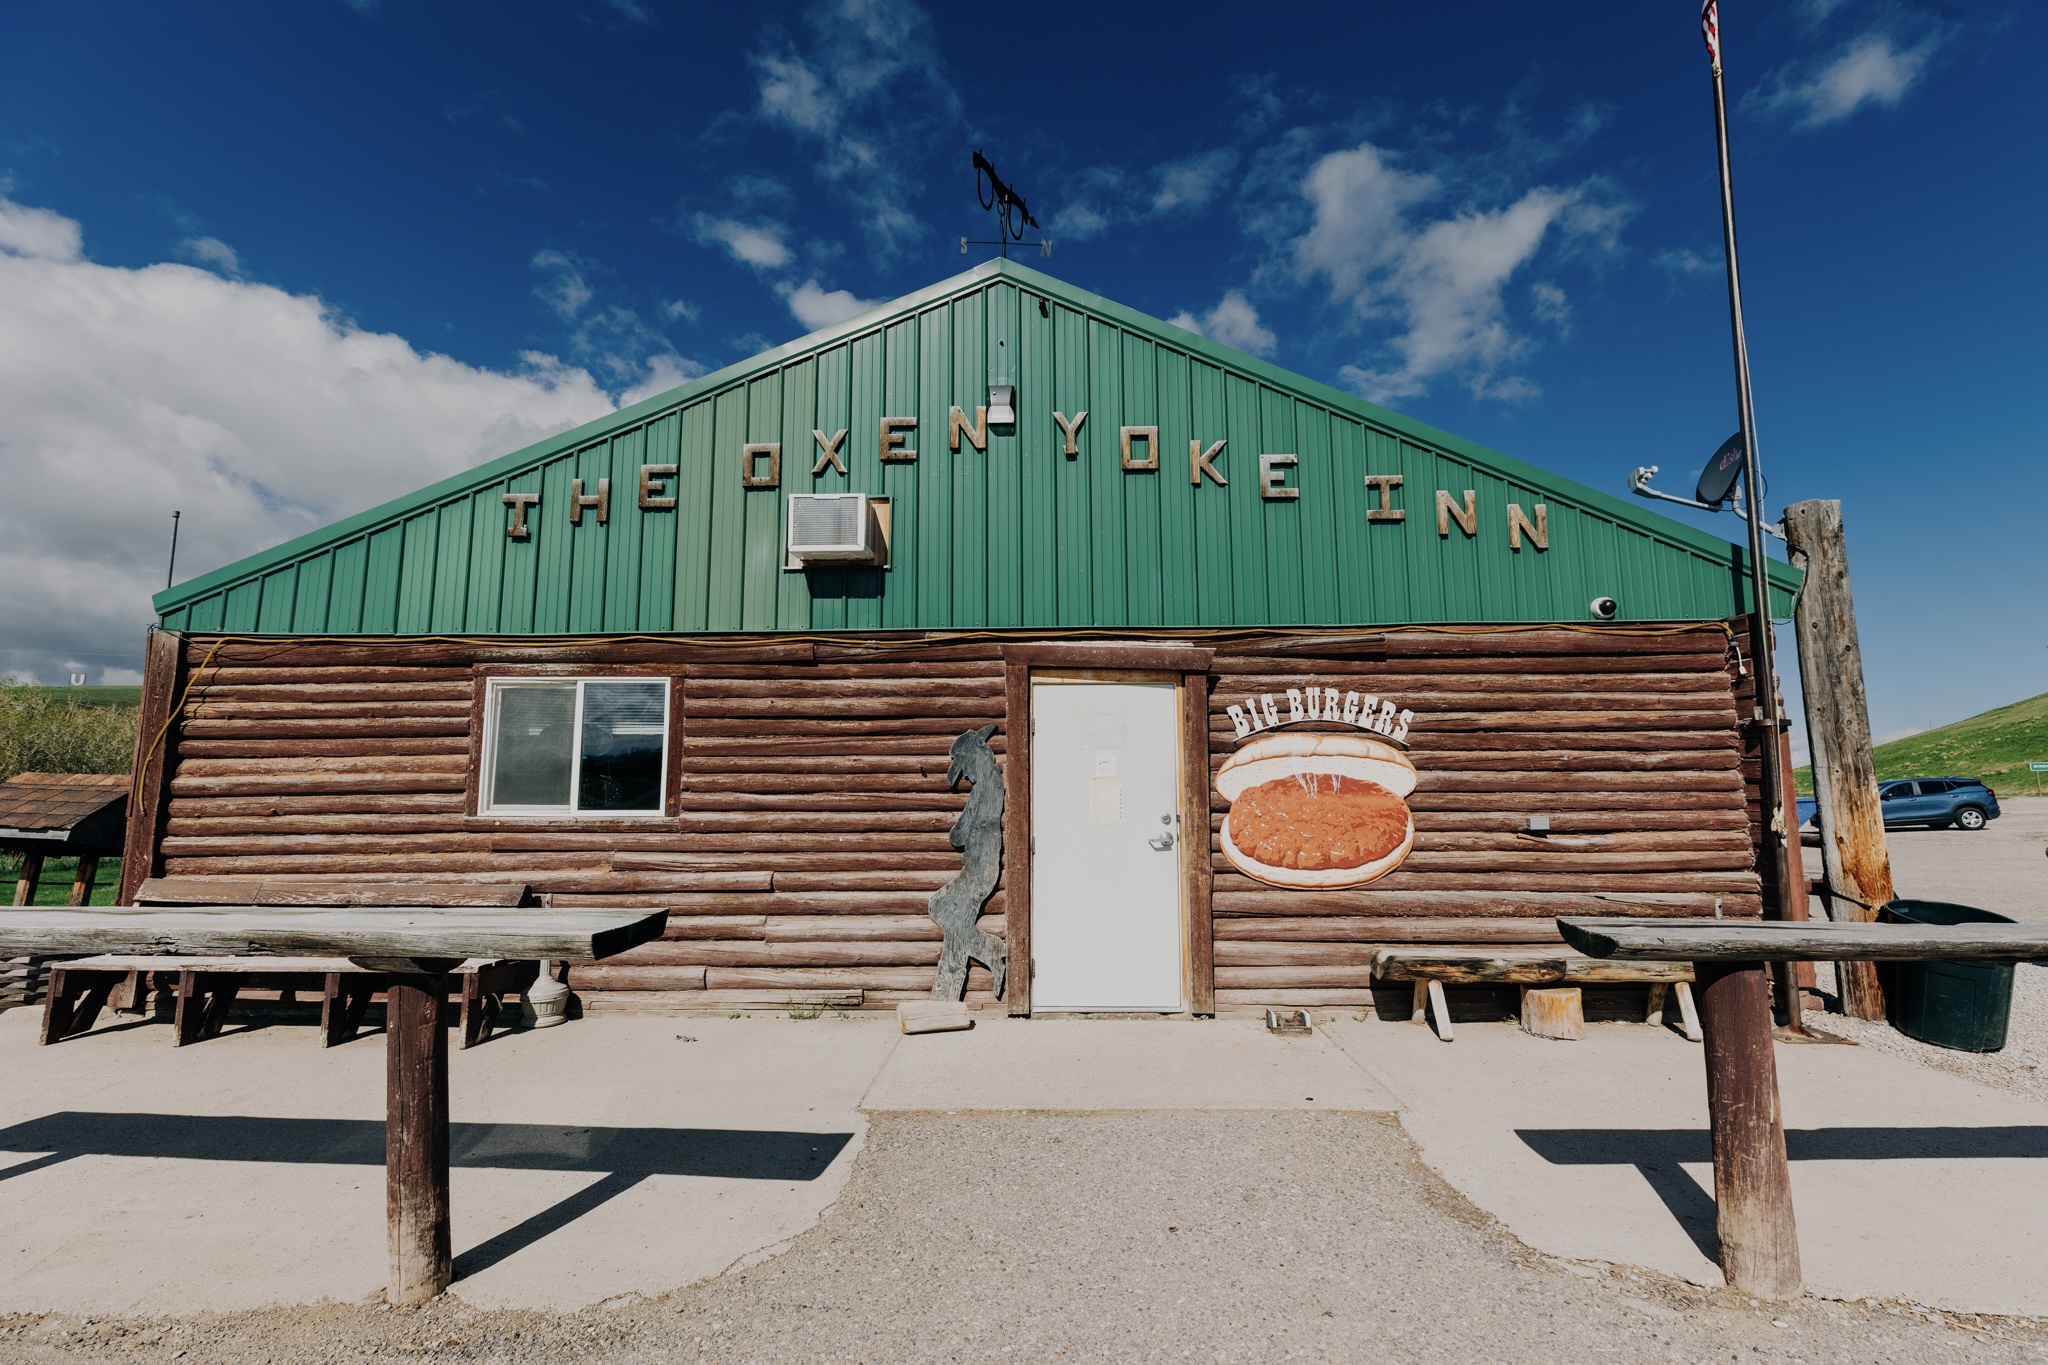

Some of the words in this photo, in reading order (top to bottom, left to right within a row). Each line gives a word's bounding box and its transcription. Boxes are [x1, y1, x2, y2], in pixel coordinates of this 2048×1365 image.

[503, 464, 678, 537] THE
[743, 405, 987, 488] OXEN
[1052, 411, 1299, 498] YOKE
[1365, 475, 1548, 549] INN
[1226, 693, 1278, 738] BIG
[1287, 687, 1415, 741] BURGERS
